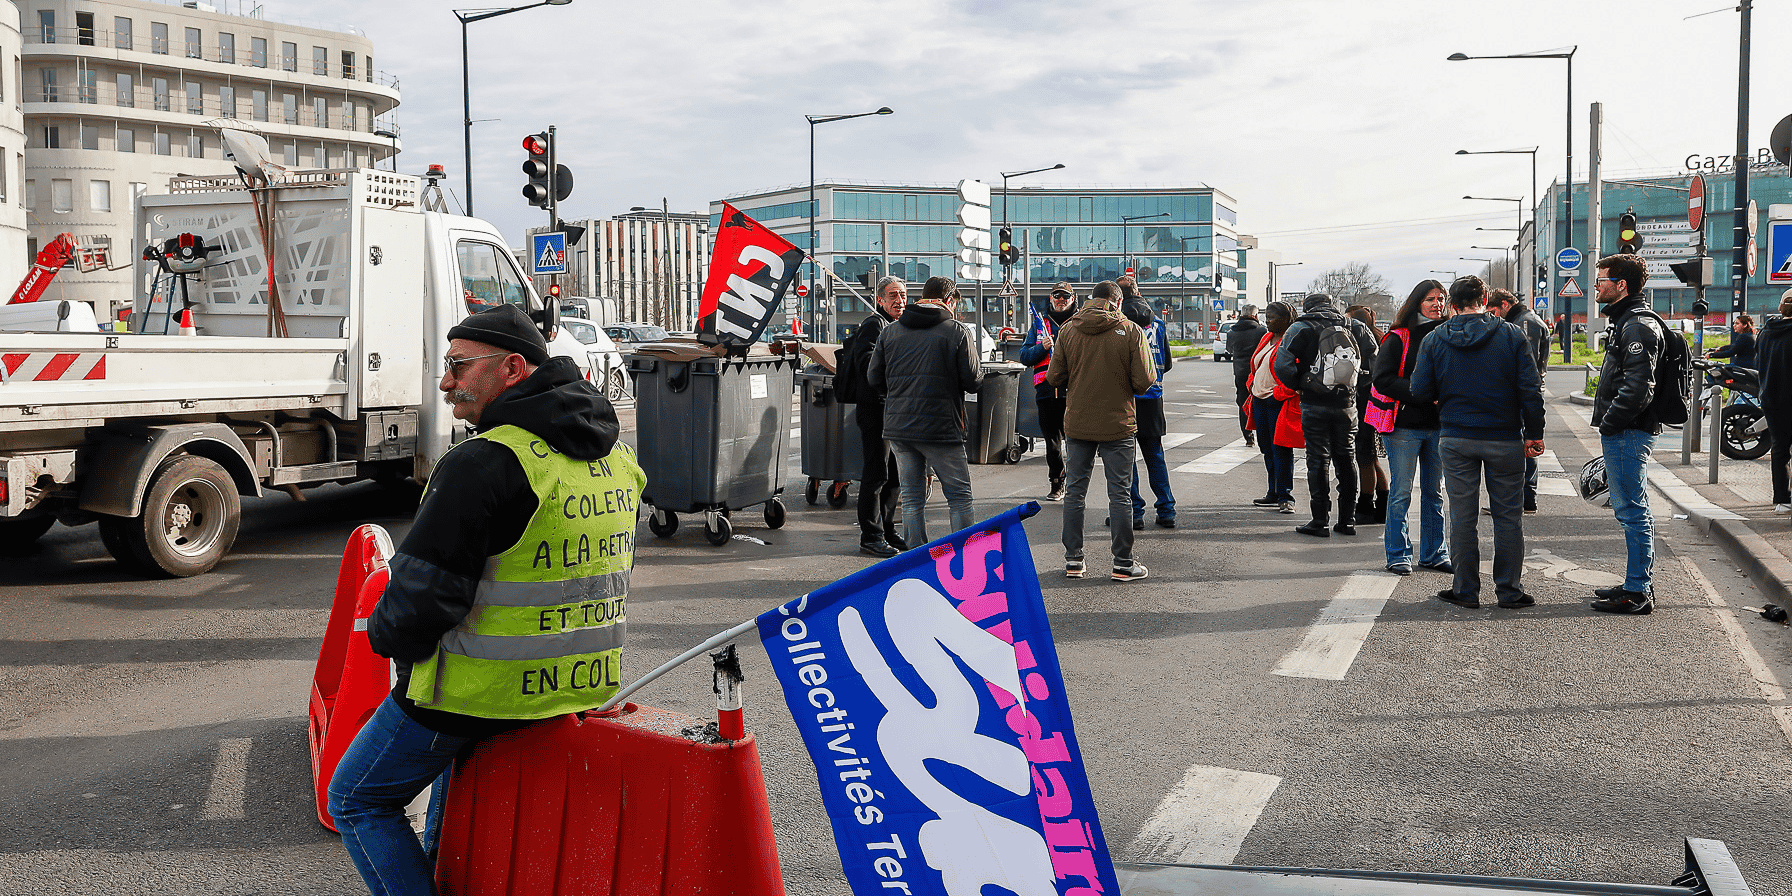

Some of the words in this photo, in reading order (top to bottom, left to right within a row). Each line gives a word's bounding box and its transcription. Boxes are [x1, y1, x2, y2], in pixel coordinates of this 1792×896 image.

[1685, 154, 1731, 170] Gaz
[22, 268, 42, 295] LOXAM
[587, 458, 613, 478] EN
[563, 488, 635, 520] COLERE
[532, 540, 552, 570] A
[562, 533, 591, 568] LA
[539, 606, 572, 632] ET
[521, 665, 559, 696] EN
[778, 593, 886, 826] Collectivités
